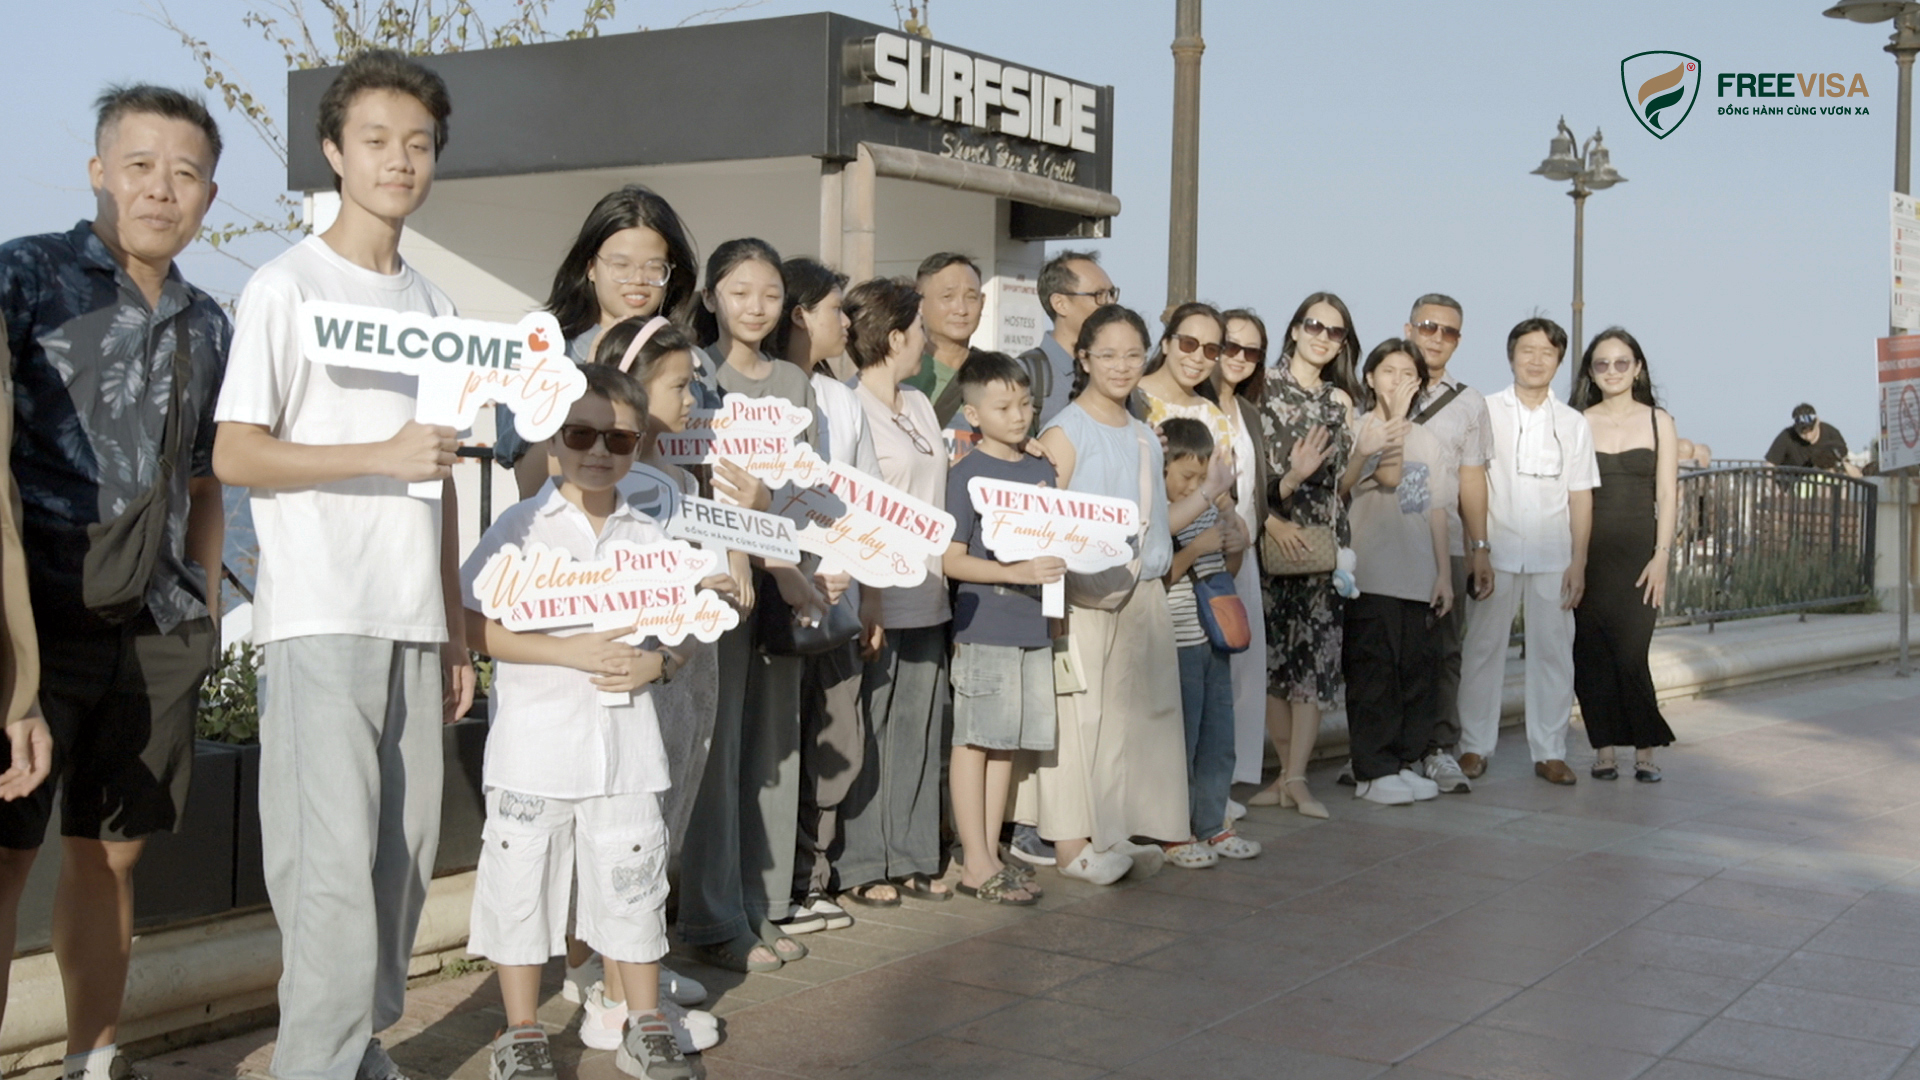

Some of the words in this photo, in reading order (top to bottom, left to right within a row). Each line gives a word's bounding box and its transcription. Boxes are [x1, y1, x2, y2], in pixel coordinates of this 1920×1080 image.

[874, 32, 1096, 153] SURFSIDE
[314, 315, 523, 371] WELCOME
[1004, 315, 1035, 329] HOSTESS
[1004, 334, 1035, 346] WANTED
[458, 358, 572, 426] party
[685, 416, 732, 430] come
[732, 401, 784, 427] Party
[681, 500, 792, 542] FREEVISA
[815, 470, 945, 544] TNAMESE
[979, 487, 1131, 526] VIETNAMESE
[857, 526, 889, 560] day
[992, 510, 1063, 550] Family
[1064, 525, 1097, 554] day
[481, 552, 616, 609] Welcome
[614, 549, 682, 574] Party
